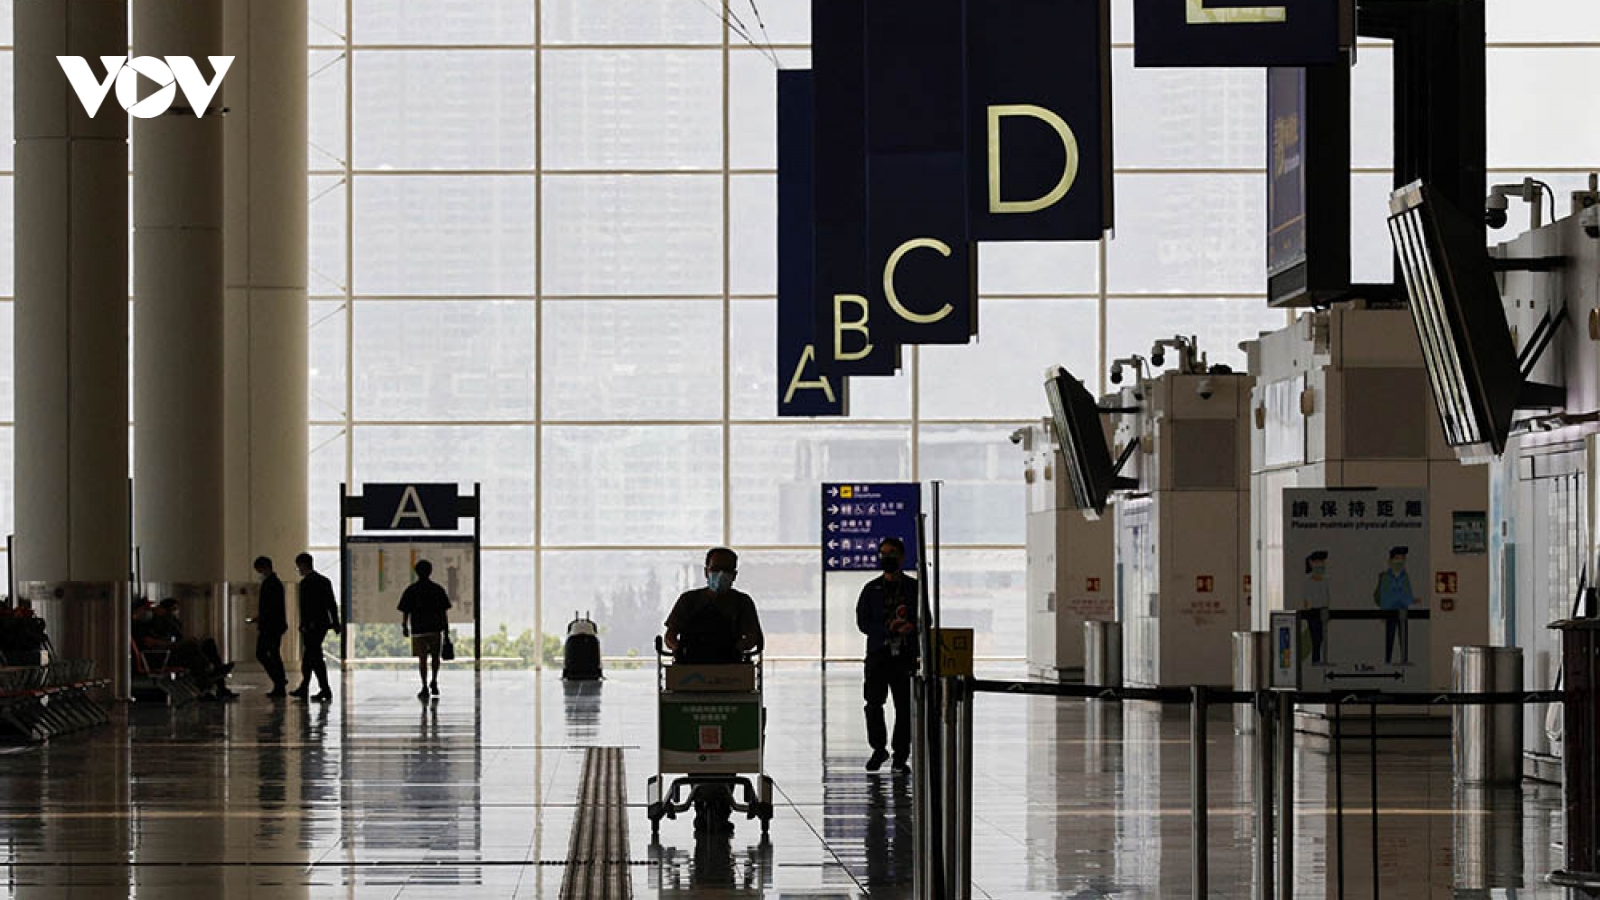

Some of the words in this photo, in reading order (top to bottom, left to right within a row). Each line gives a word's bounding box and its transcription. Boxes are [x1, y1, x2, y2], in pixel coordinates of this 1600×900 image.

[987, 104, 1079, 214] D
[883, 238, 954, 324] C
[833, 294, 874, 362] B
[783, 345, 836, 404] A
[390, 485, 431, 529] A
[1292, 520, 1318, 529] Please
[1320, 520, 1354, 529] maintain
[1355, 520, 1388, 531] physical
[1389, 520, 1422, 529] distance
